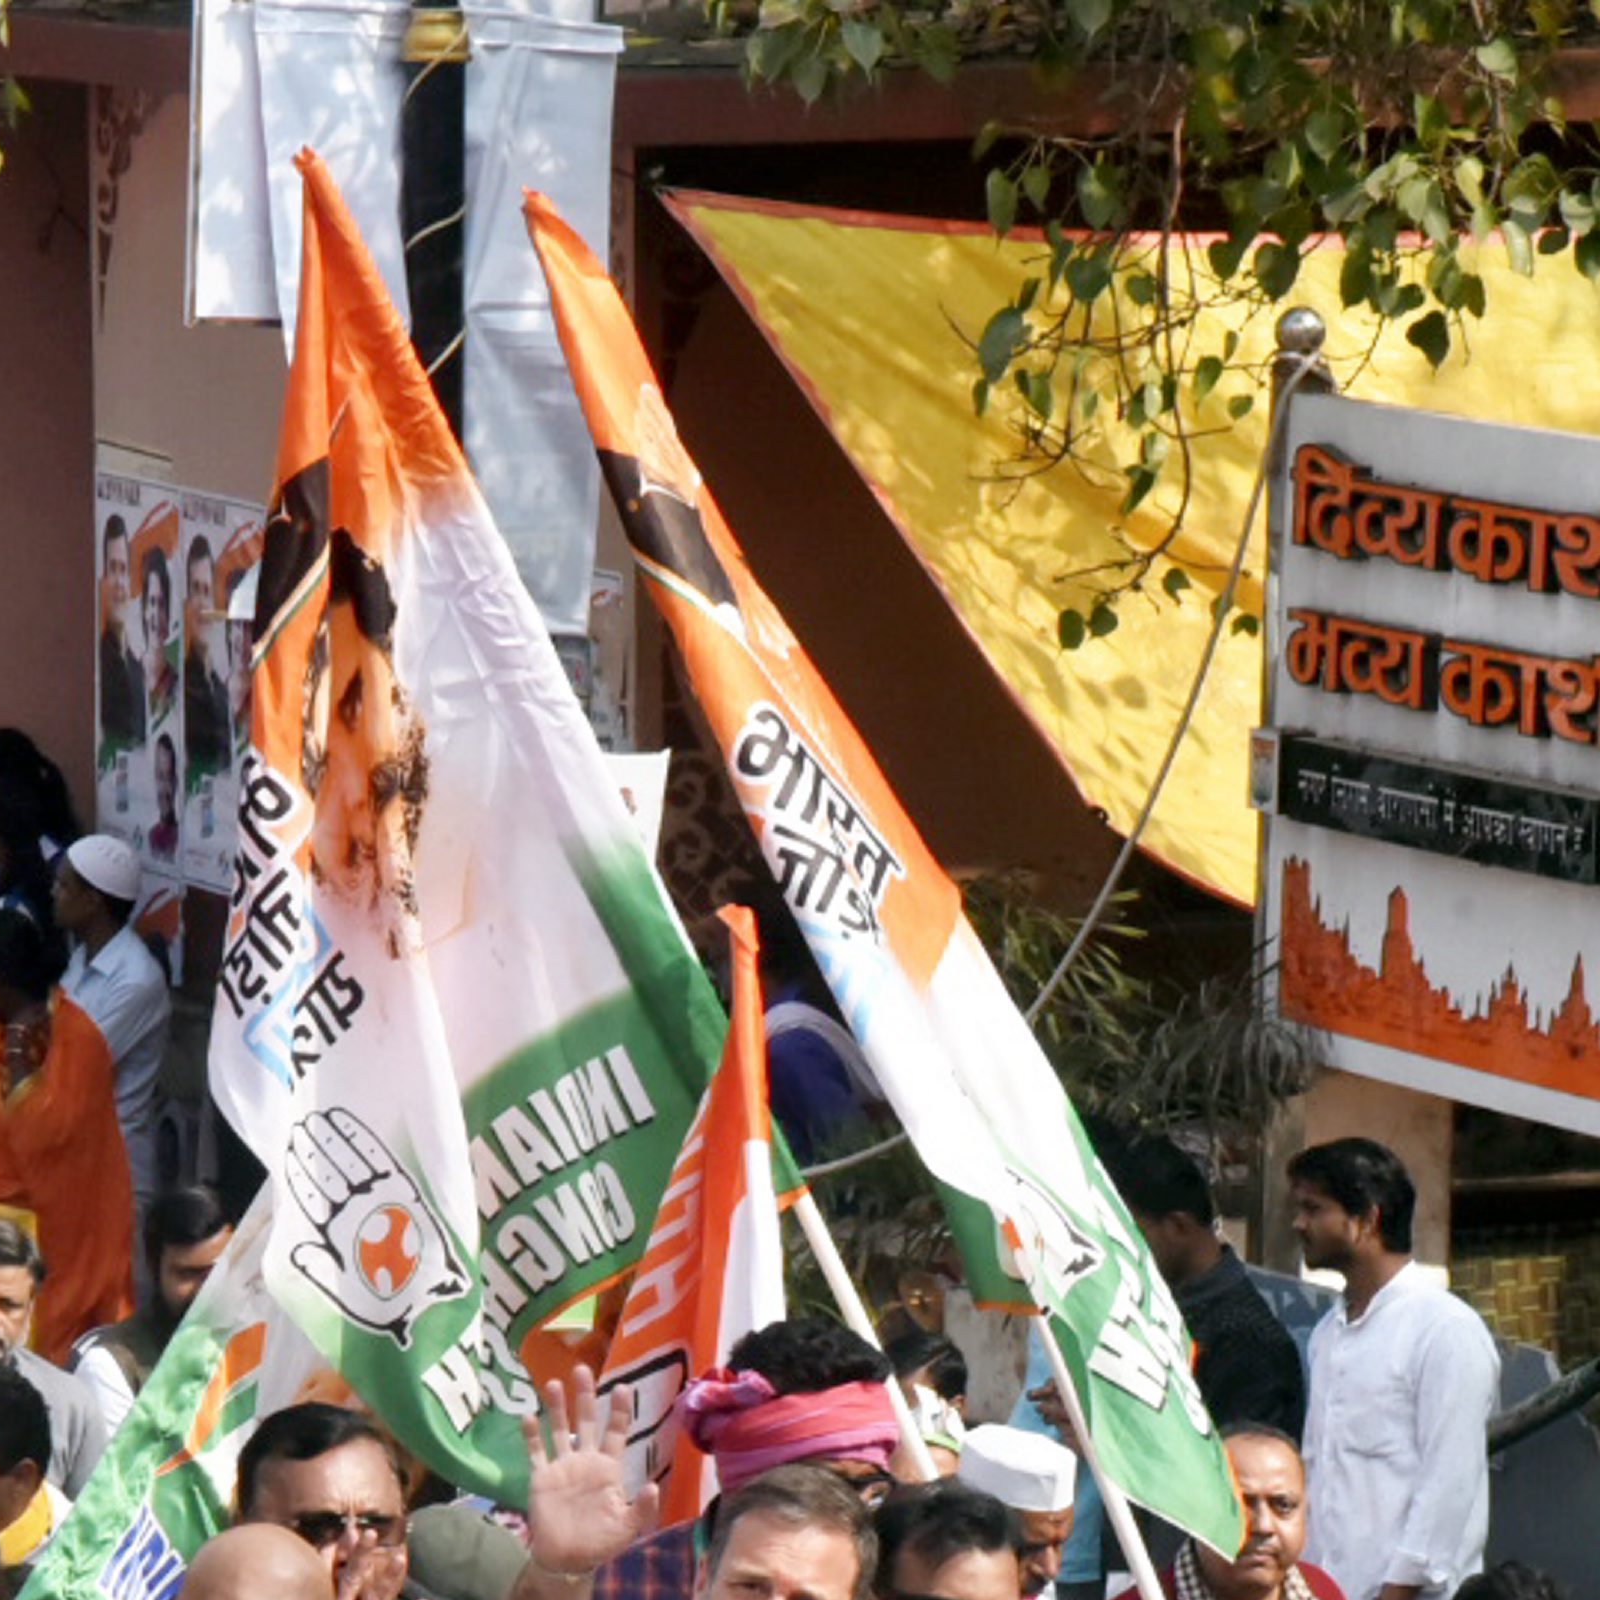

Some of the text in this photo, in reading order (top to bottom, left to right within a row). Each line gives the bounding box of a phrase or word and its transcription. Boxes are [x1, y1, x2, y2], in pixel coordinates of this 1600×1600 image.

[1290, 443, 1448, 570] दिव्य
[1286, 607, 1430, 710] भव्य
[736, 708, 903, 899] भारत
